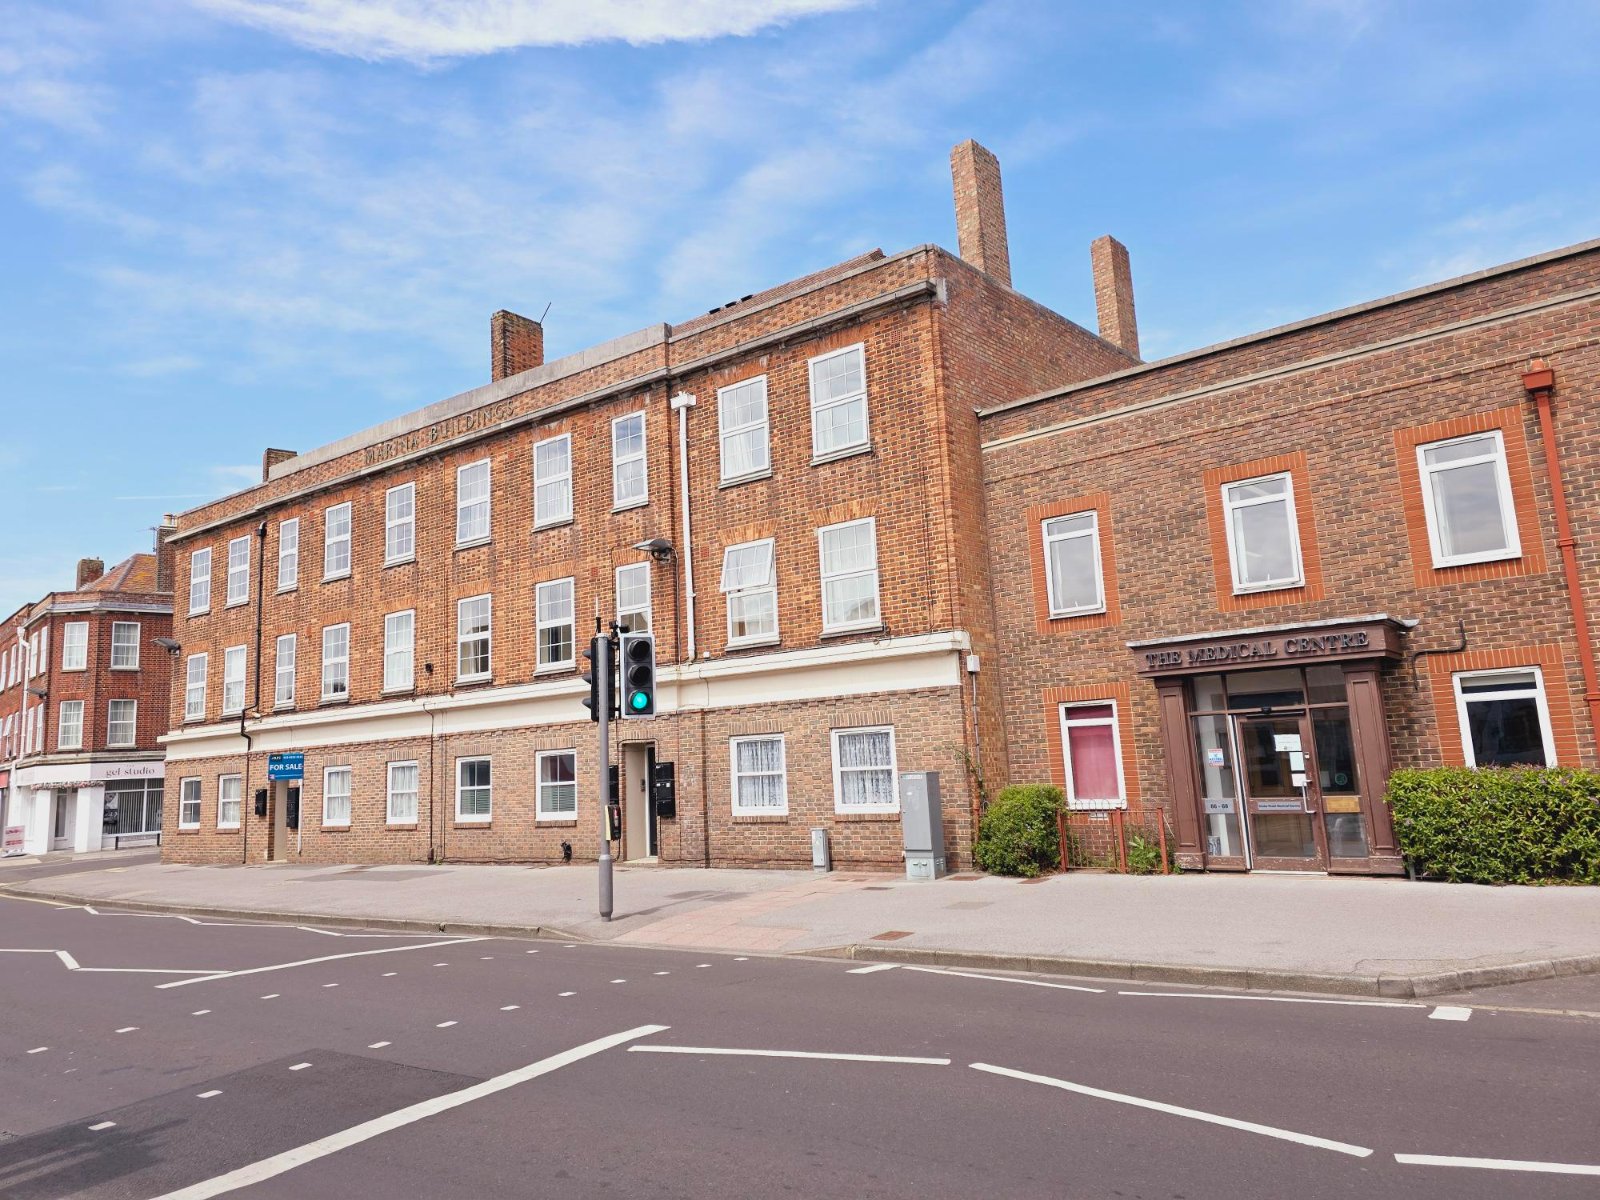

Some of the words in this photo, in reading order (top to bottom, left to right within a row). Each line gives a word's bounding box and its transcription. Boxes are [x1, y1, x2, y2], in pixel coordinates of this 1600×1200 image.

[365, 434, 419, 464] MARINA
[429, 402, 515, 443] BUILDINGS
[1146, 651, 1182, 667] THE
[1188, 641, 1277, 663] MEDICAL
[1284, 631, 1369, 654] CENTRE
[124, 766, 155, 775] studio
